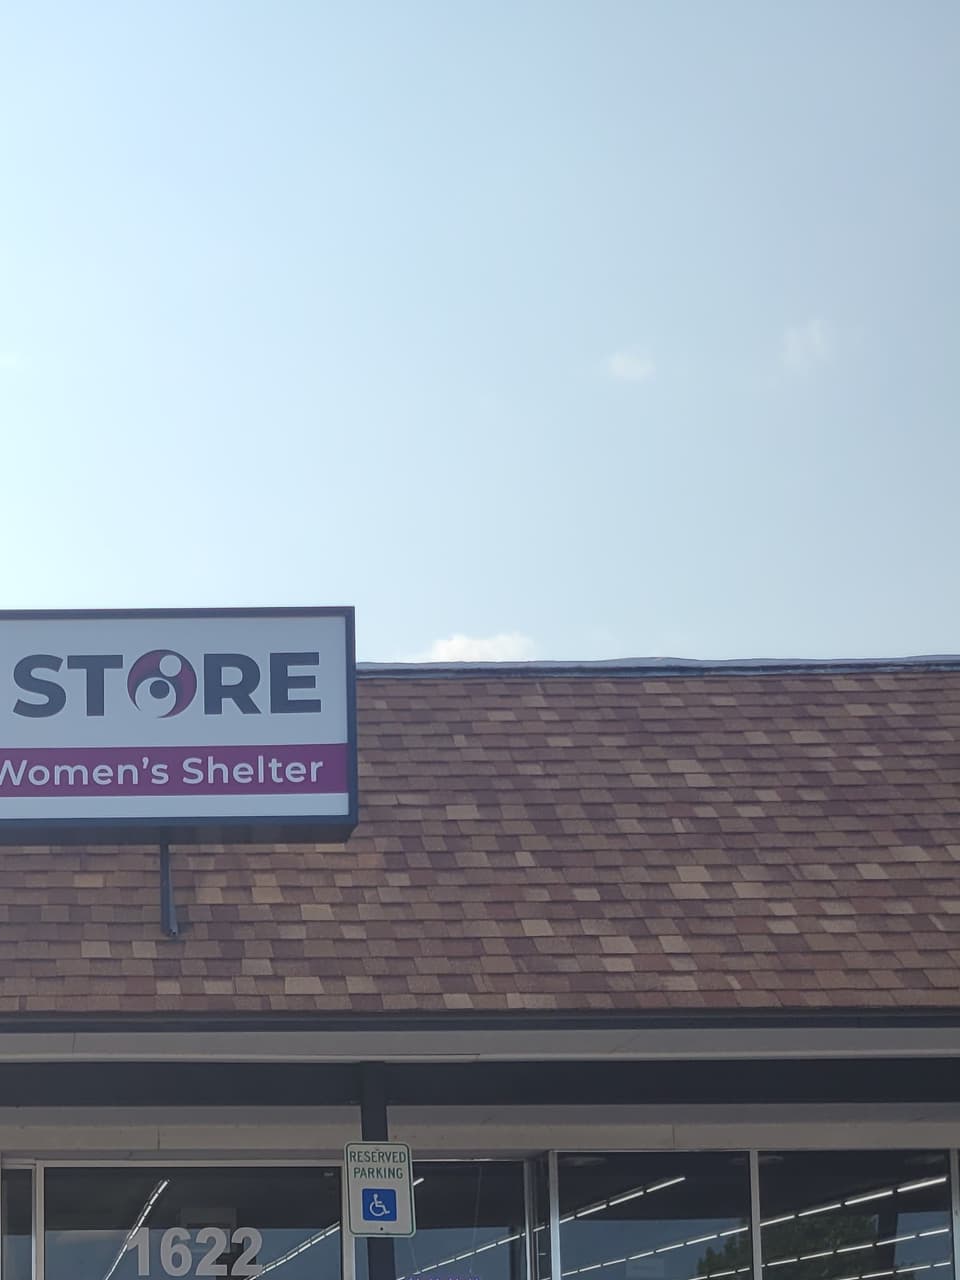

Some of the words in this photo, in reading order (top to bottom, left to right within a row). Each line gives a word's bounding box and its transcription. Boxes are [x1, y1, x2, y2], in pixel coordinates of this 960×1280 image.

[182, 755, 323, 784] Shelter
[349, 1151, 407, 1164] RESERVED
[353, 1167, 404, 1180] PARKING
[127, 1226, 264, 1277] 1622
